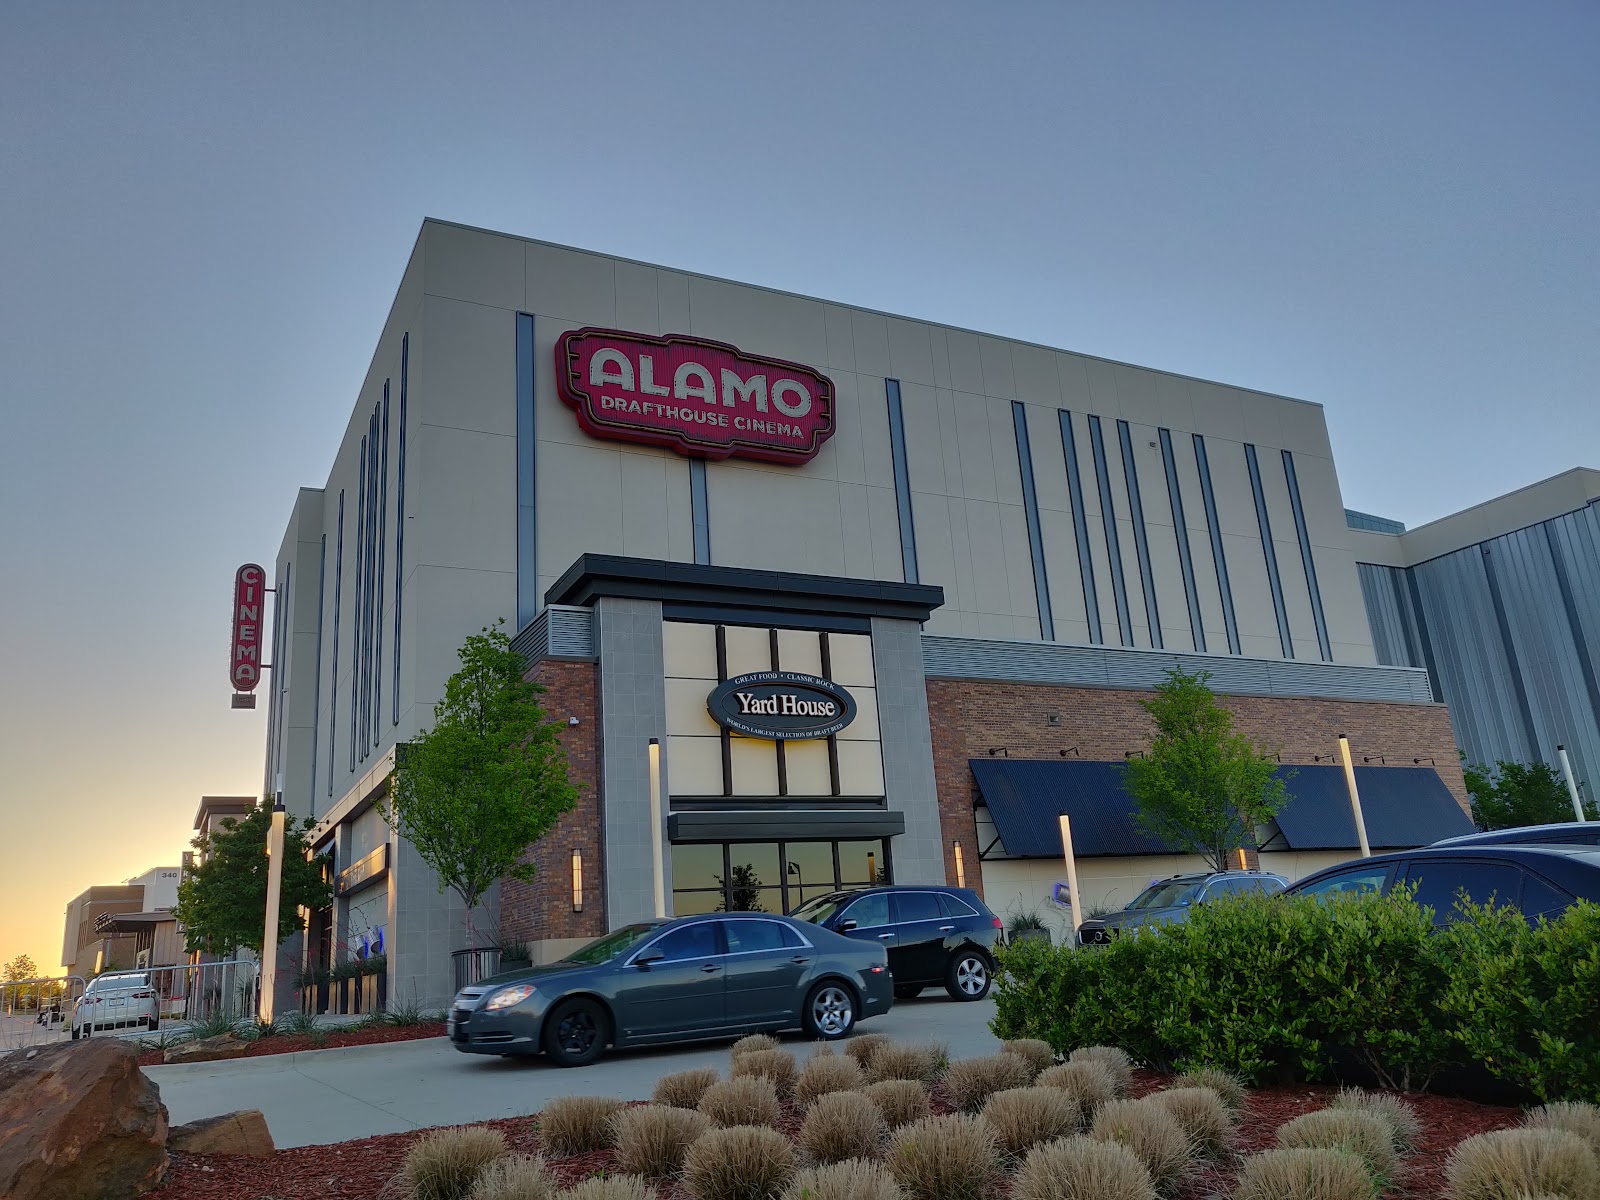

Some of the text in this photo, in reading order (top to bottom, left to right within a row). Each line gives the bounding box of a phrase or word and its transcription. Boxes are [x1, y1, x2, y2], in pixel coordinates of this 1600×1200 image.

[589, 347, 812, 418] ALAMO
[601, 395, 804, 439] DRAFTHOUSE CINEMA
[236, 567, 259, 680] CINEMA
[734, 674, 758, 685] GREAT
[786, 673, 815, 683] CLASSIC
[815, 679, 836, 690] ROCK
[736, 692, 836, 717] Yard House
[726, 717, 750, 732] WORLD'S
[750, 727, 776, 737] LARGEST
[813, 728, 831, 737] DRAFT
[831, 722, 844, 733] BEER
